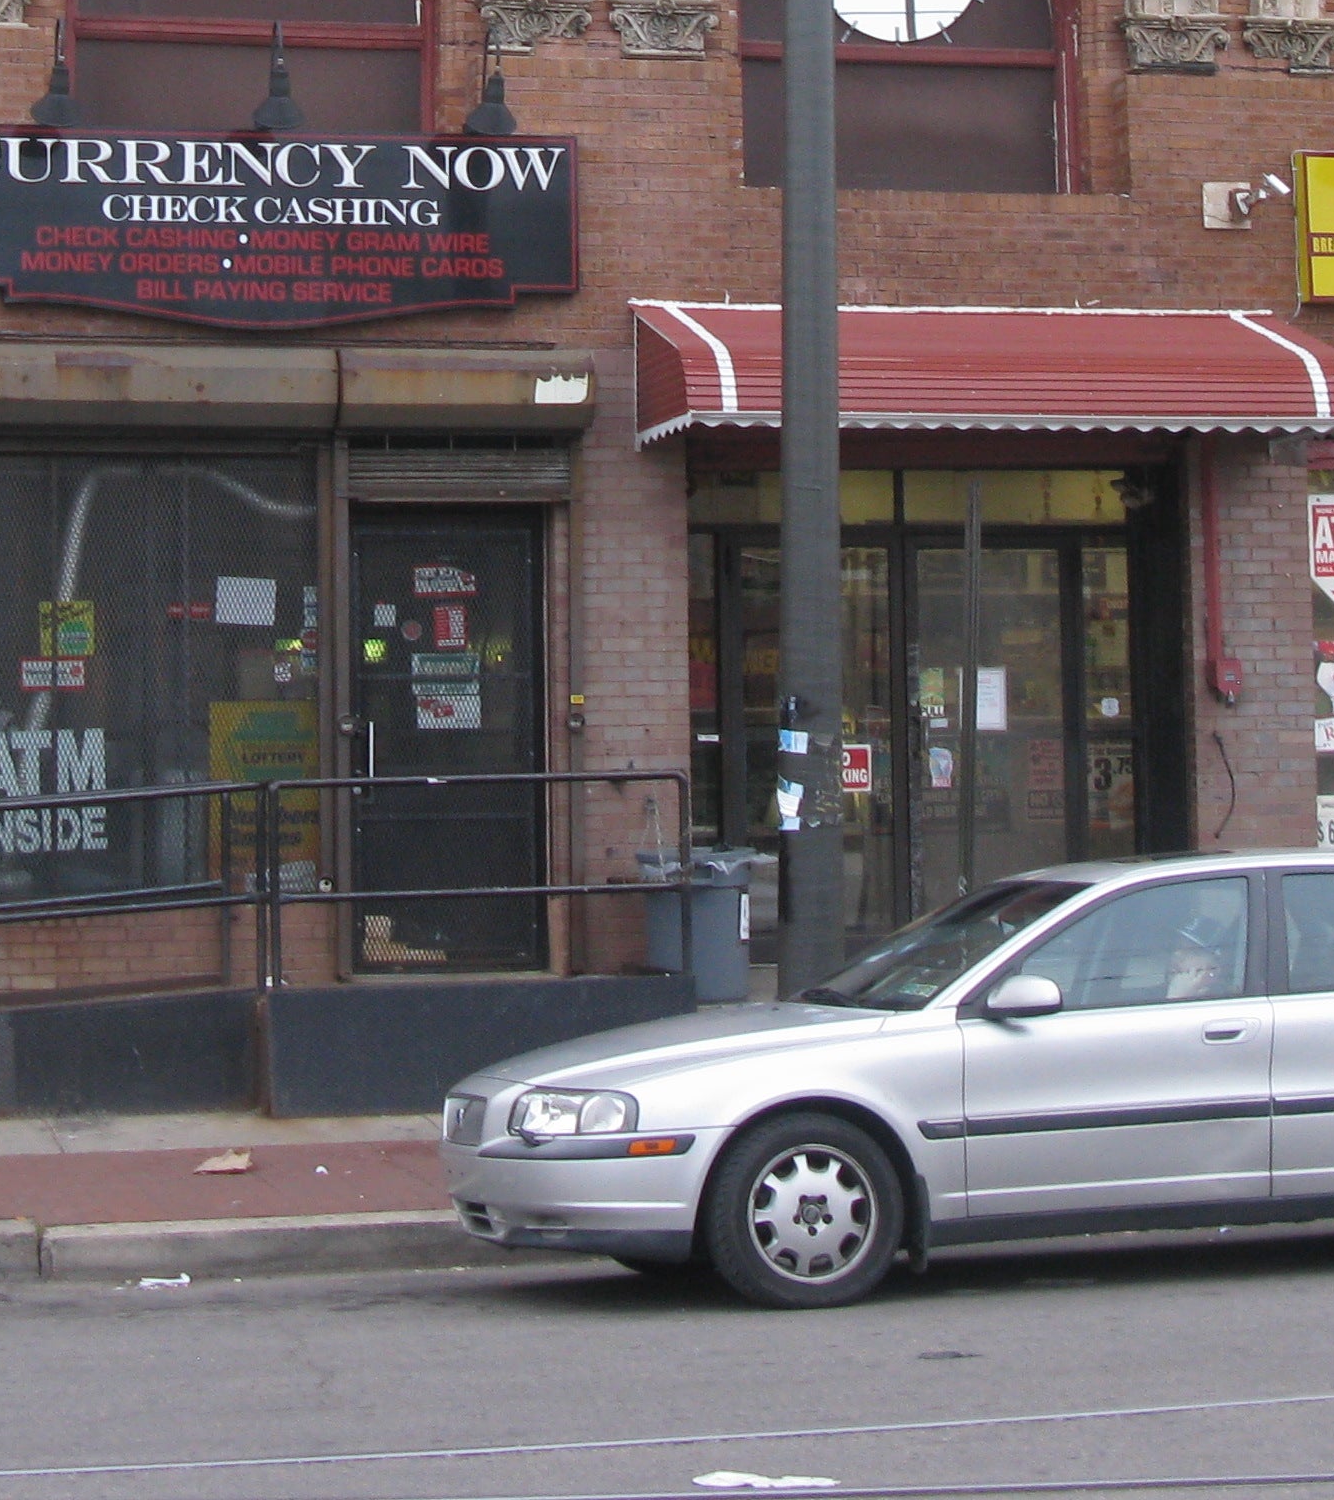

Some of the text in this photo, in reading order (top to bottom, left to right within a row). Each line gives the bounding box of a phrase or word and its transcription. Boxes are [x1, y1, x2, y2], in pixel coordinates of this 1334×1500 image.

[401, 145, 565, 192] NOW
[102, 193, 441, 226] CHECK CASHING
[36, 225, 491, 254] CHECK CASHING MONEY GRAM WIRE
[21, 251, 505, 279] MONEY ORDERS MOBILE PHONE CARDS
[136, 278, 393, 304] BILL PAYING SERVICE
